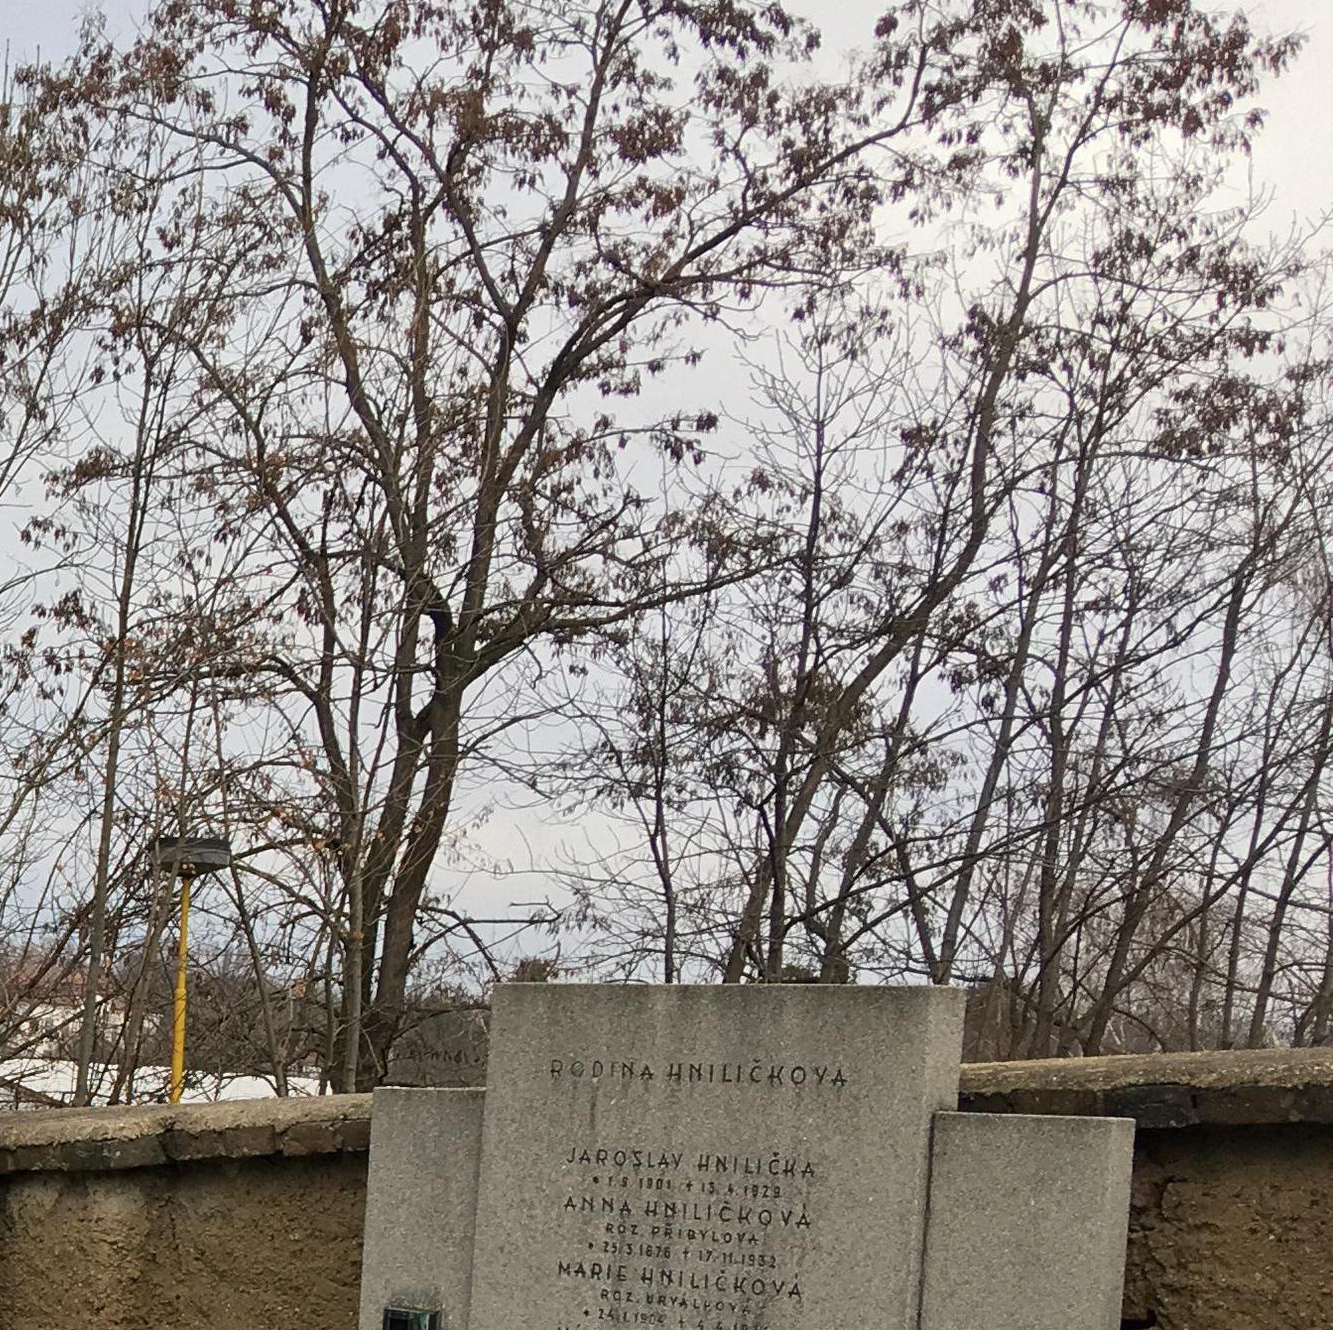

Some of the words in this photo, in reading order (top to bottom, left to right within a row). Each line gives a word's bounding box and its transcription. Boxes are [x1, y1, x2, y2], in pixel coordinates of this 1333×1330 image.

[550, 1059, 654, 1080] RODINA
[565, 1147, 685, 1169] JAROSLAV
[696, 1151, 816, 1178] HNILIČKA
[563, 1195, 632, 1217] ANNA
[644, 1201, 812, 1229] HNILIČKOVÁ
[557, 1260, 628, 1282] MARIE
[640, 1266, 803, 1299] HNILIČKOVÁ
